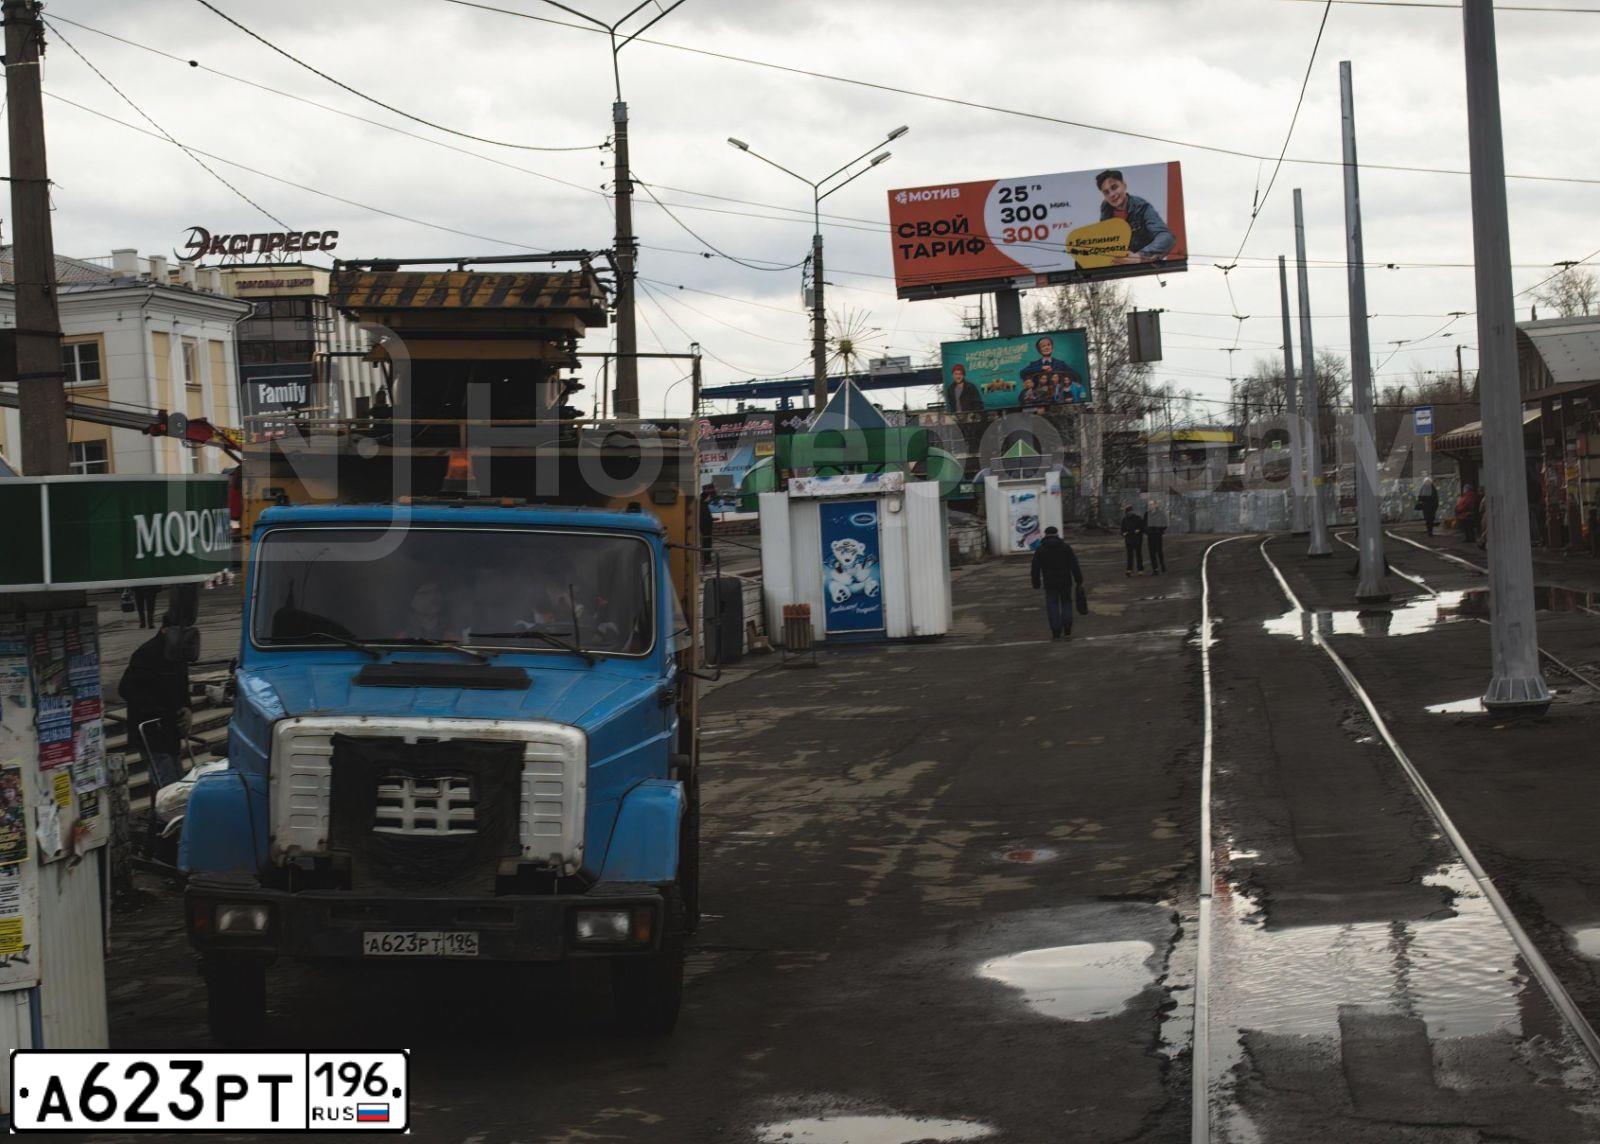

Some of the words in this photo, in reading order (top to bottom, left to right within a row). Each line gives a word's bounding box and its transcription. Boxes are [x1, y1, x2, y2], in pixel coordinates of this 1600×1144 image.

[908, 188, 961, 202] МОТИВ
[998, 186, 1029, 204] 25
[1000, 204, 1048, 224] 300
[898, 214, 969, 238] СВОЙ
[1002, 224, 1049, 243] 300
[173, 226, 339, 261] ЭКСПРЕСС
[899, 236, 986, 260] ТАРИФ
[259, 382, 306, 403] Family
[369, 933, 441, 953] А623РТ
[446, 934, 473, 949] 196
